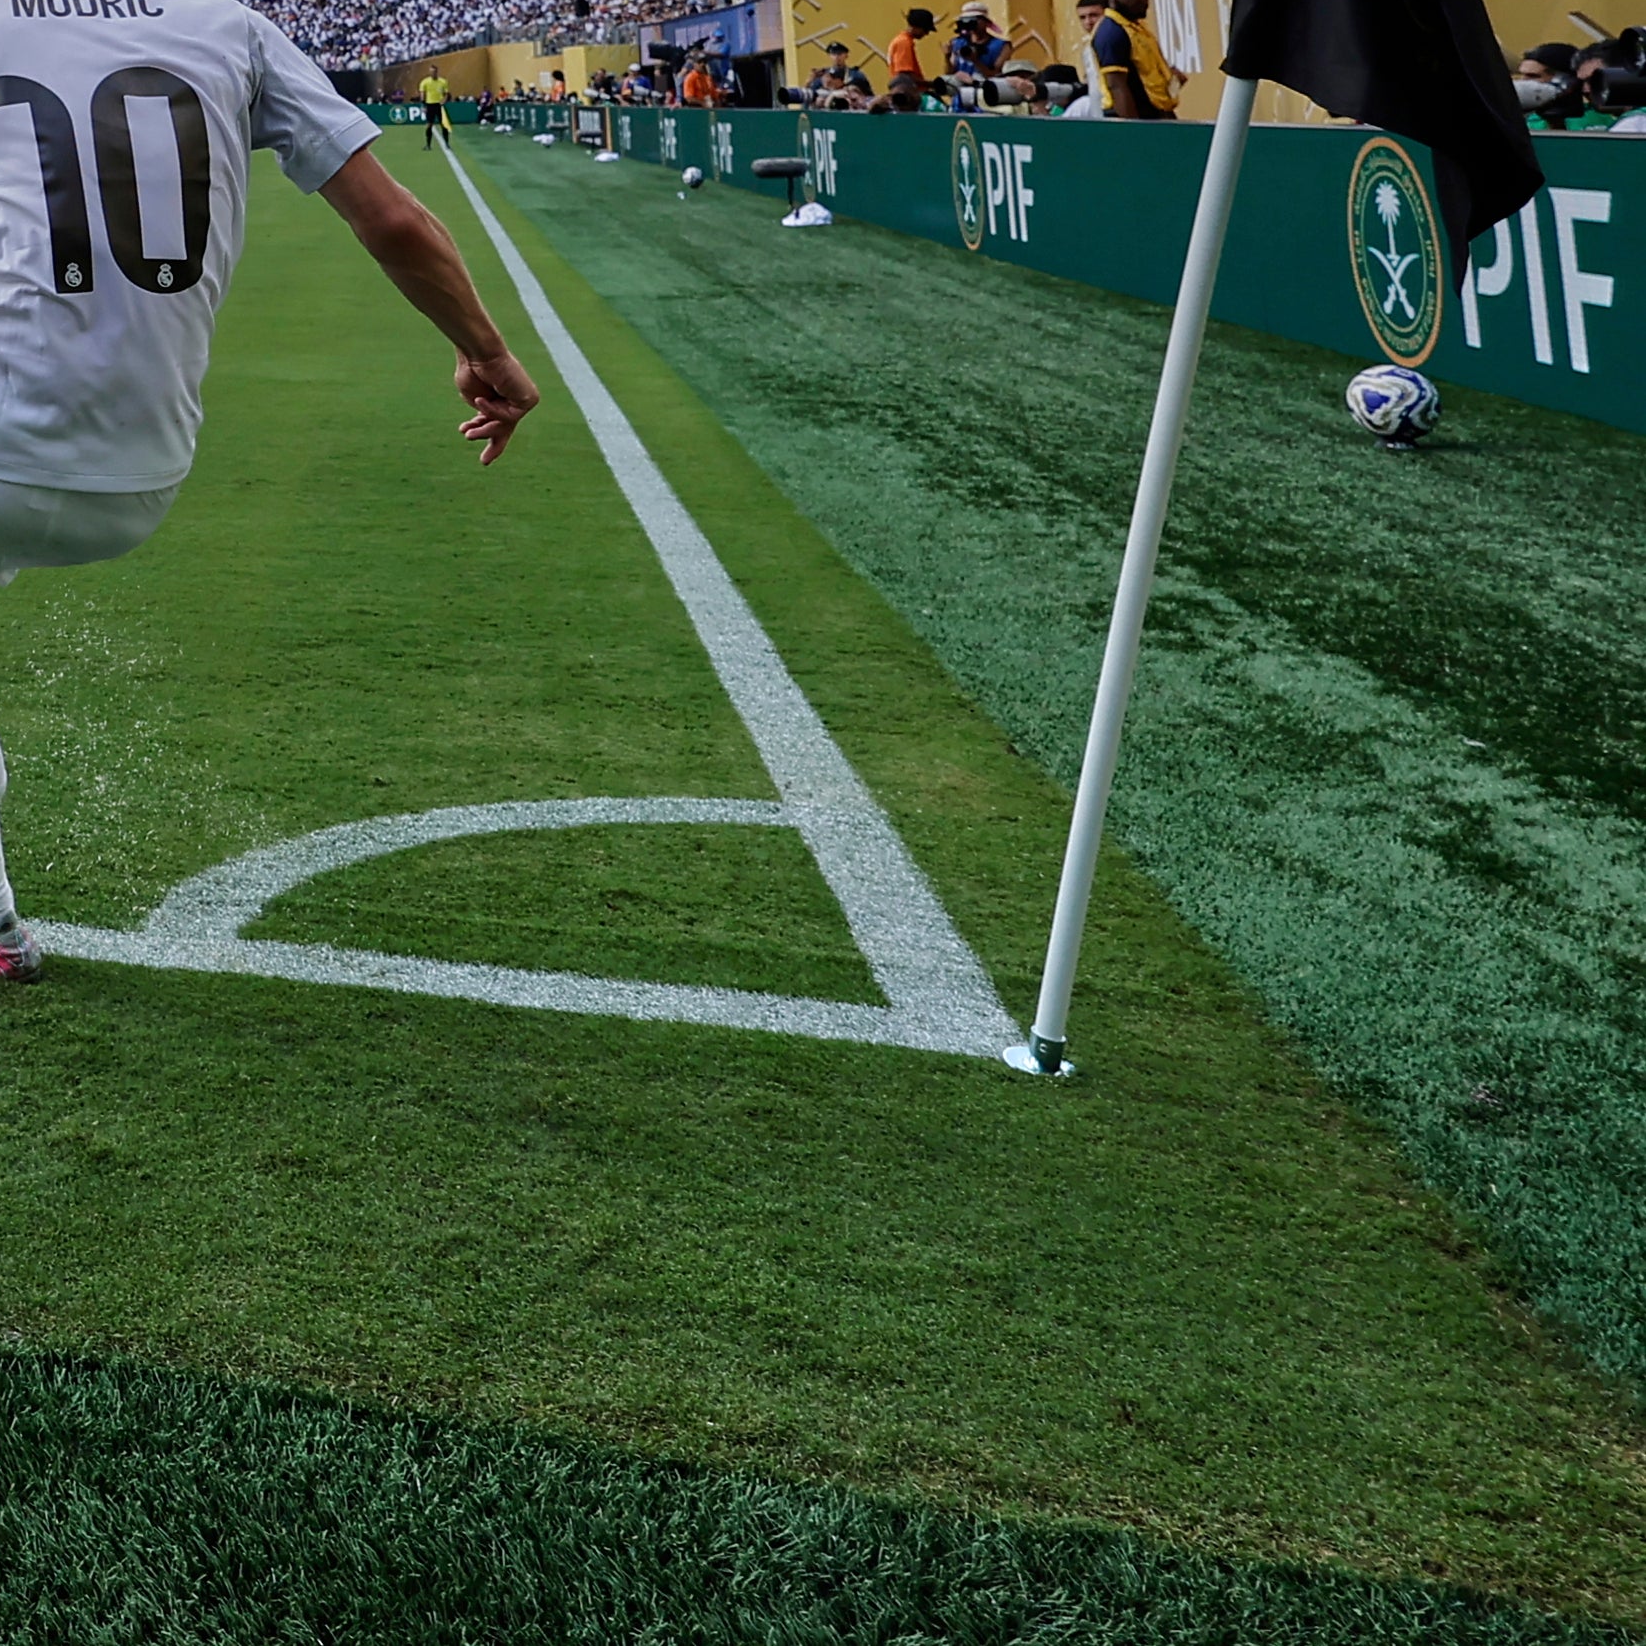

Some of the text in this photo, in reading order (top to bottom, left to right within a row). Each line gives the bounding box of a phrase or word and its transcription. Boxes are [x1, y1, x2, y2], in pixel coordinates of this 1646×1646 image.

[409, 106, 427, 121] PI
[812, 128, 838, 197] PIF
[981, 141, 1034, 243] PIF
